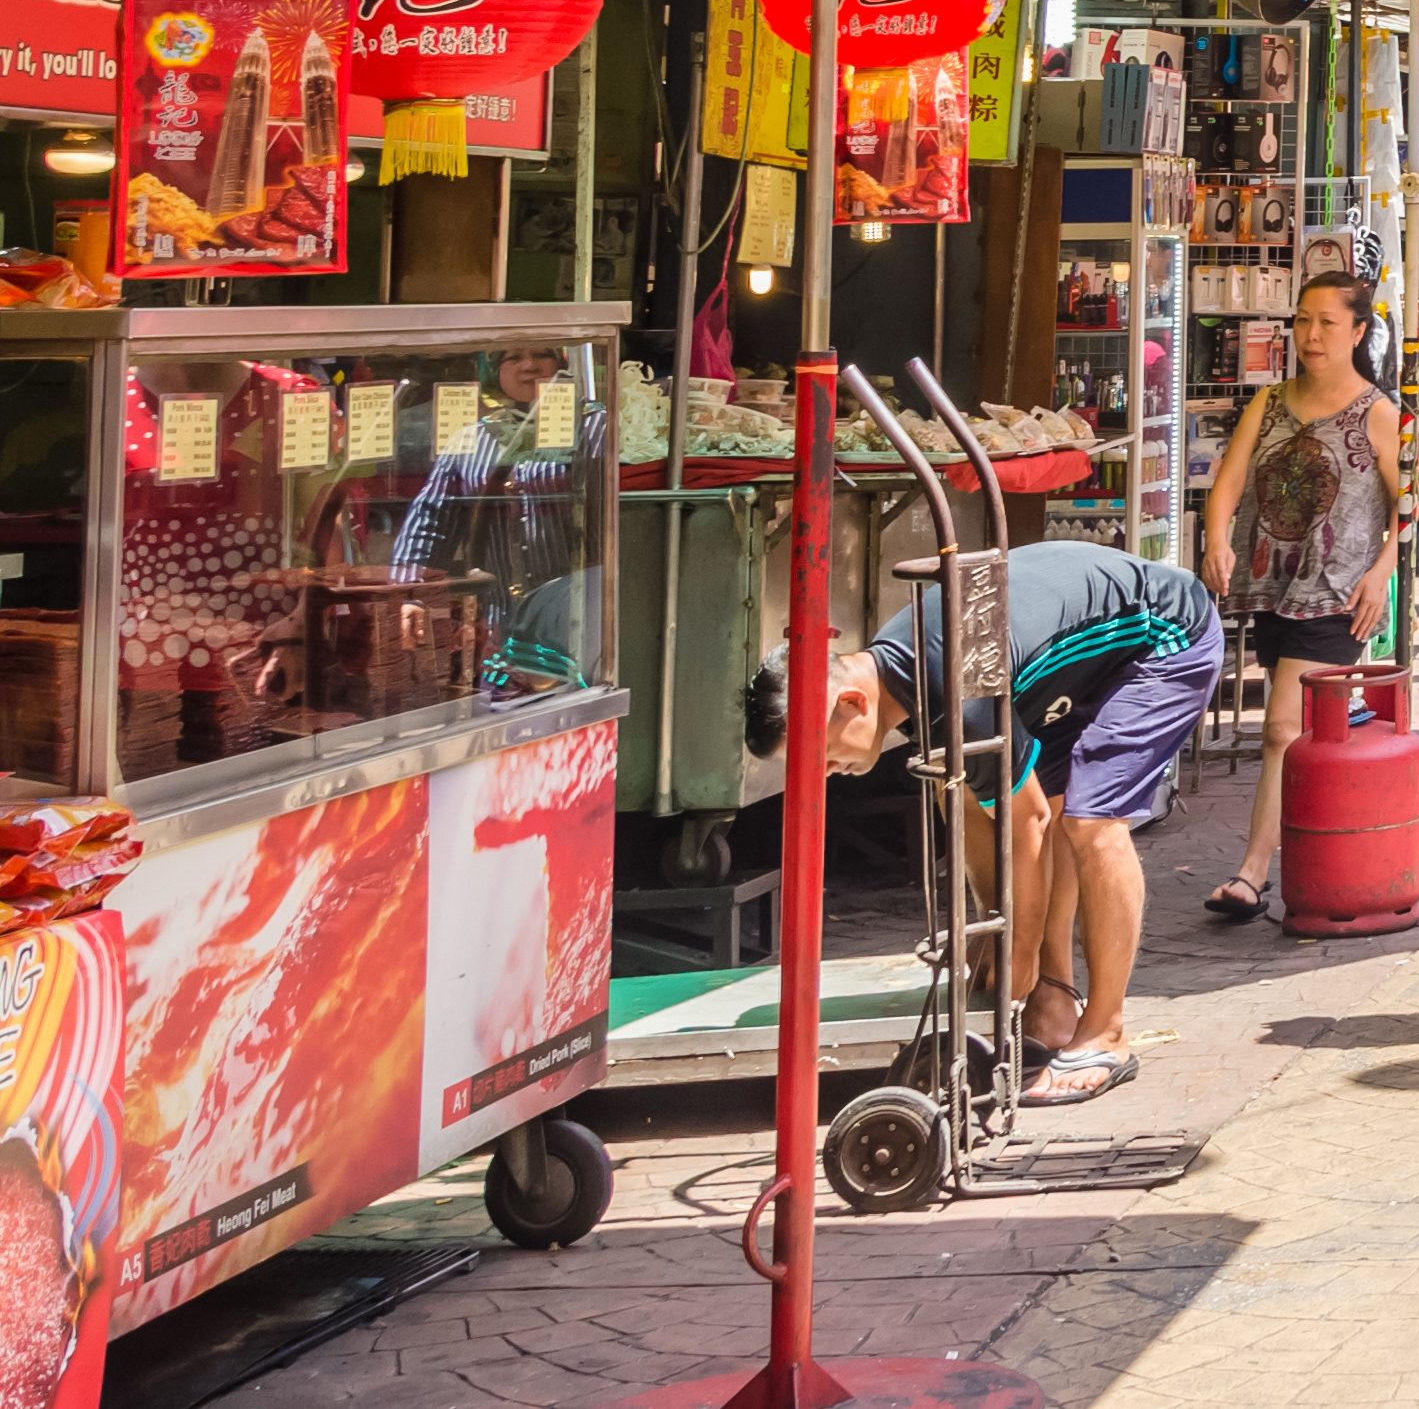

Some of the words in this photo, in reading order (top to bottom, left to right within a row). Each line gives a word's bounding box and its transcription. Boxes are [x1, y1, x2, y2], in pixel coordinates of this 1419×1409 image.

[17, 42, 36, 76] it,
[42, 48, 95, 81] you'll
[98, 52, 117, 80] lo
[529, 1052, 551, 1076] Dried
[551, 1044, 569, 1065] Pork
[570, 1032, 592, 1060] (Slice)
[452, 1088, 468, 1114] A1
[217, 1206, 252, 1238] Heong
[253, 1194, 270, 1220] Fei
[272, 1181, 297, 1210] Meat
[120, 1251, 143, 1287] A5
